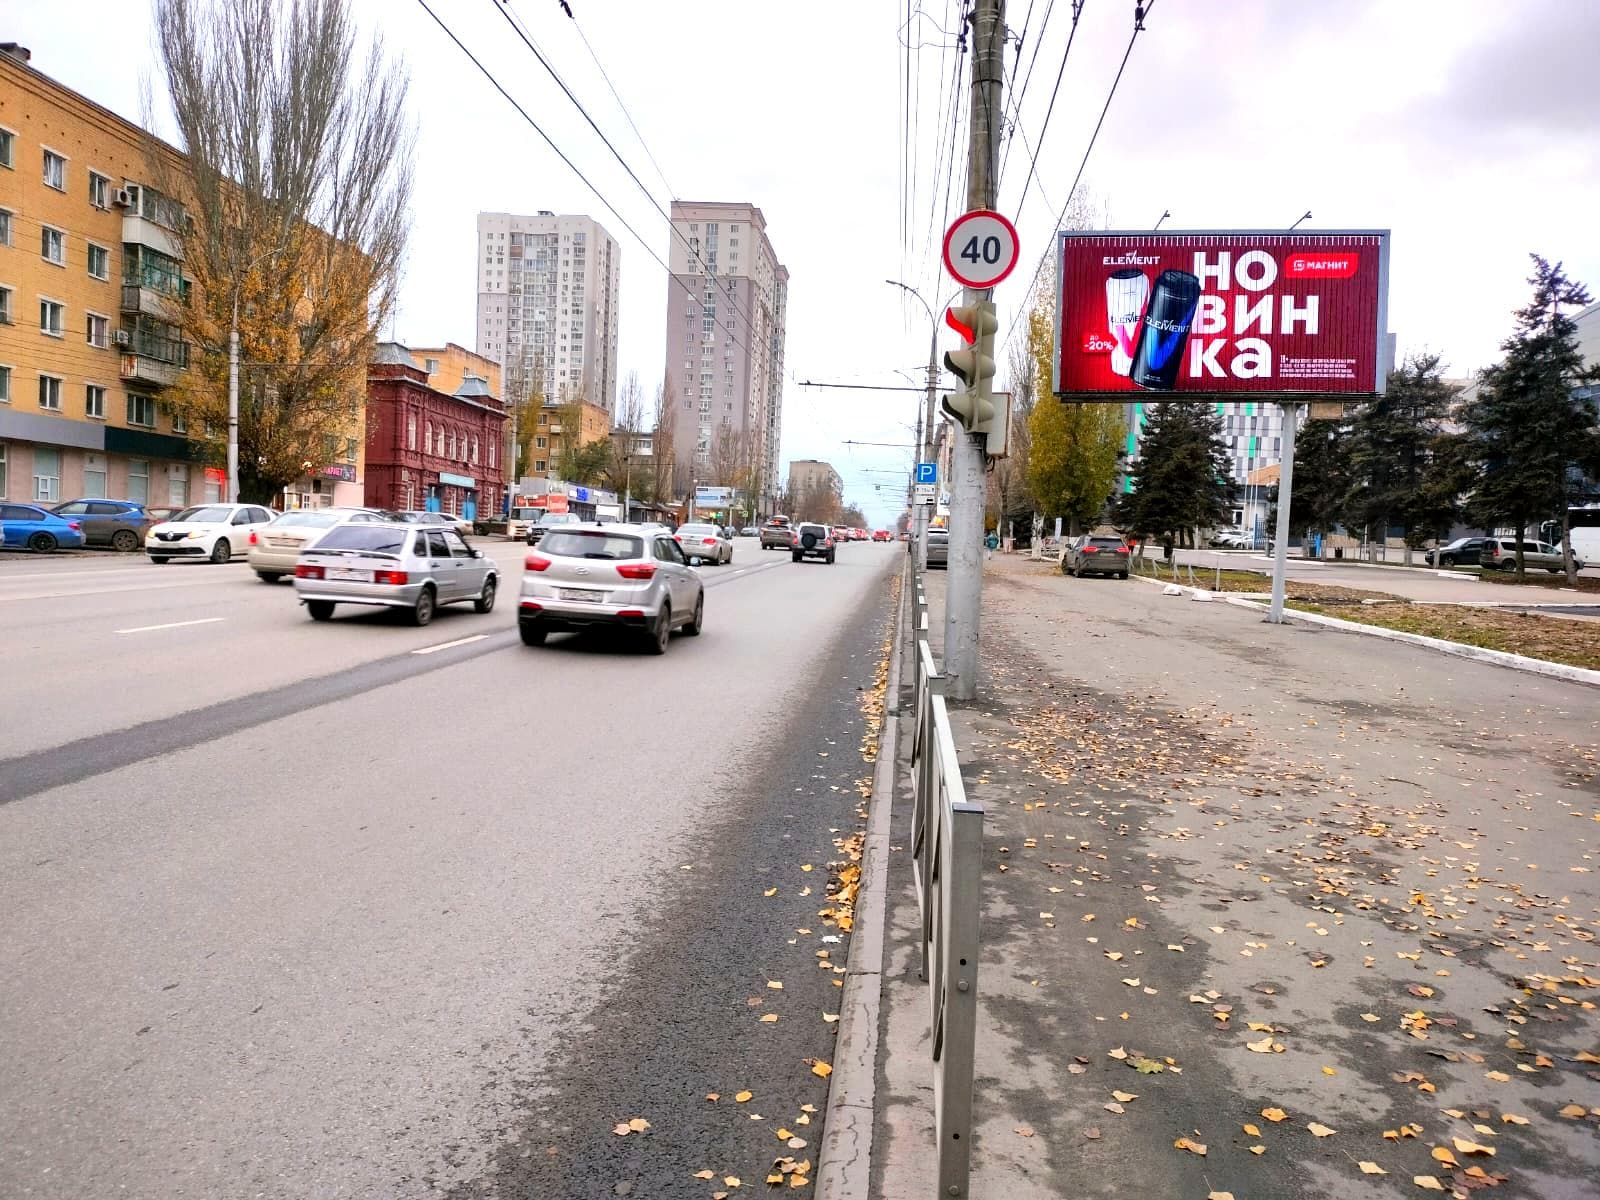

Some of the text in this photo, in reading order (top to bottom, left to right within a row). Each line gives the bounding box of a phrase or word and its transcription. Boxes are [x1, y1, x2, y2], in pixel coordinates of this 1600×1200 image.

[960, 235, 1001, 264] 40
[1102, 250, 1161, 265] ELEMENT
[1306, 261, 1349, 270] МАГНИТ
[1084, 341, 1115, 351] -20%
[920, 465, 933, 481] P
